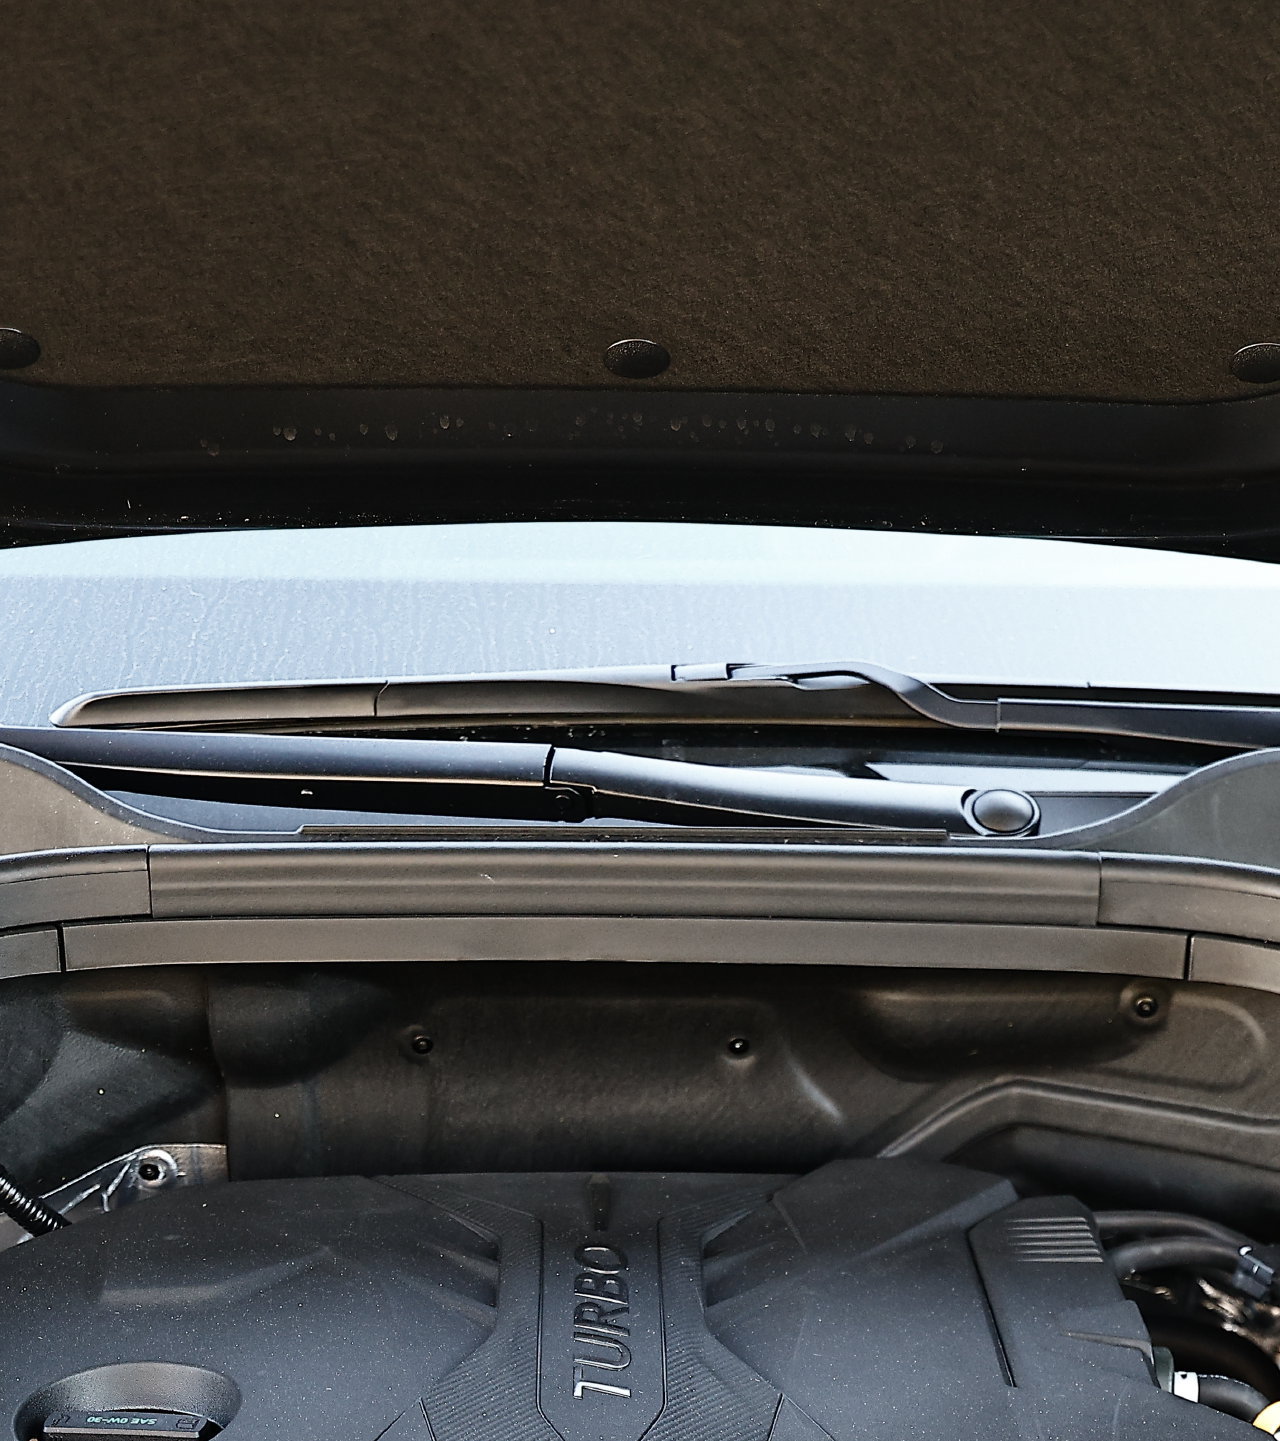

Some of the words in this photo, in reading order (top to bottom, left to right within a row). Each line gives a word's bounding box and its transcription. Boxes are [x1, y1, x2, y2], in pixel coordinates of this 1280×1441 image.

[573, 1243, 632, 1400] TURBO
[86, 1416, 129, 1424] 0W-30
[130, 1417, 158, 1425] SAE
